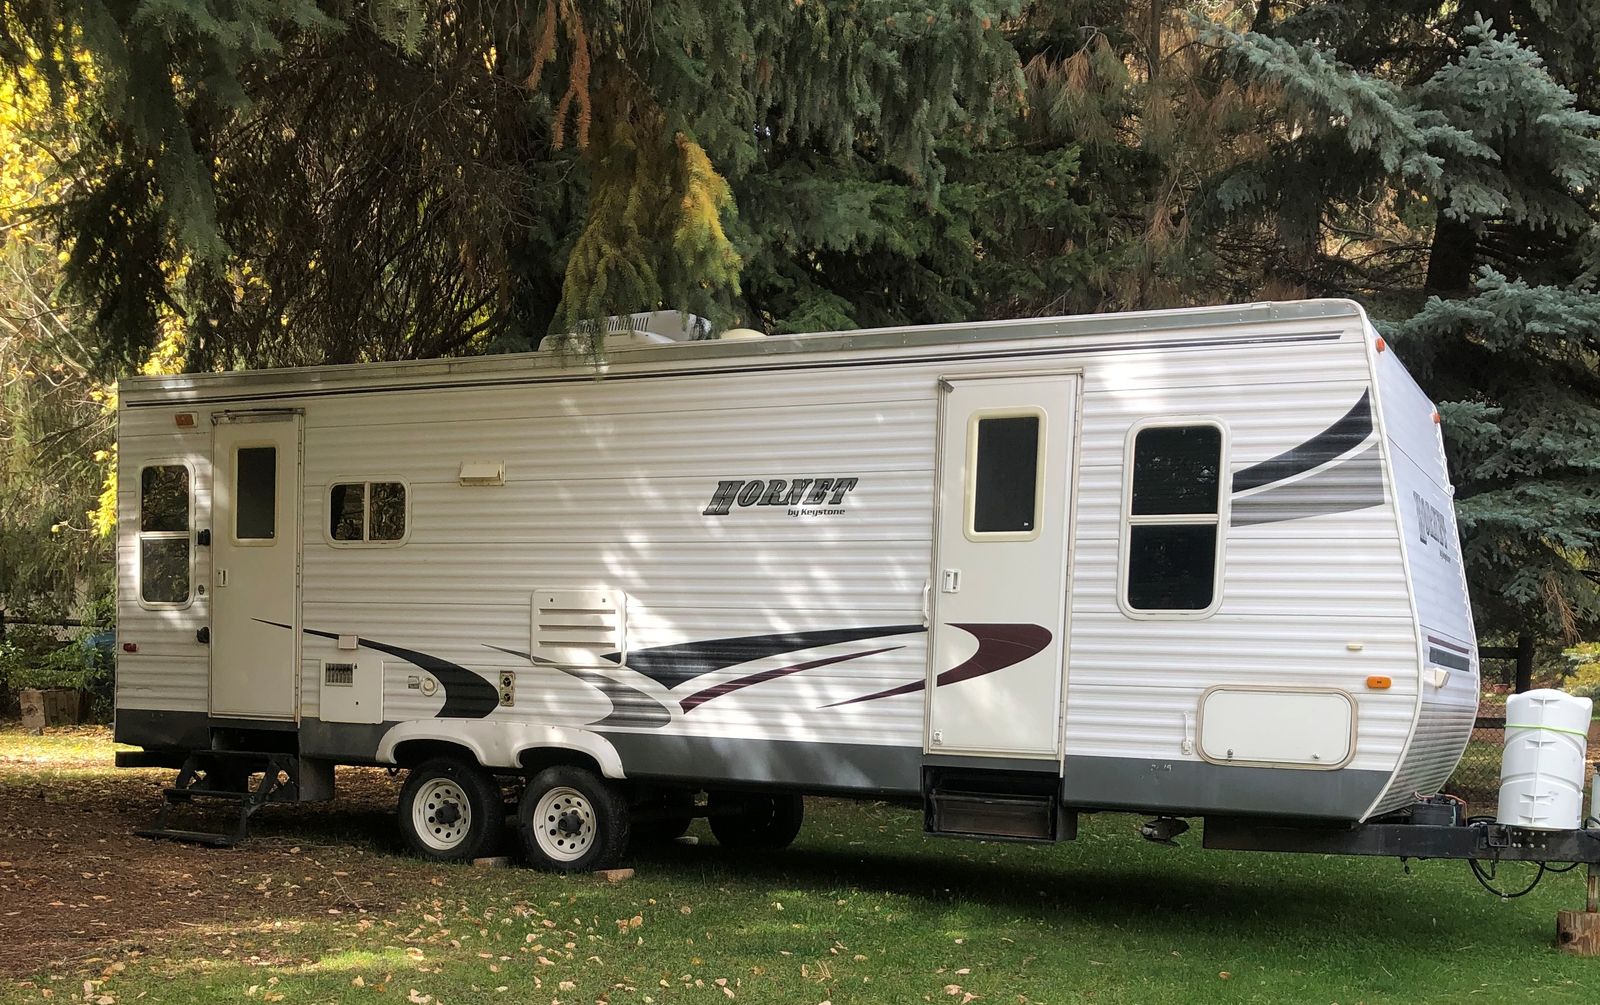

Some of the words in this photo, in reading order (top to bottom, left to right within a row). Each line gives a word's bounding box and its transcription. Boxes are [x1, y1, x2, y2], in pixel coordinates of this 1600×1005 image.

[702, 478, 859, 516] HORNET
[787, 508, 800, 518] by
[800, 508, 846, 517] Keystone
